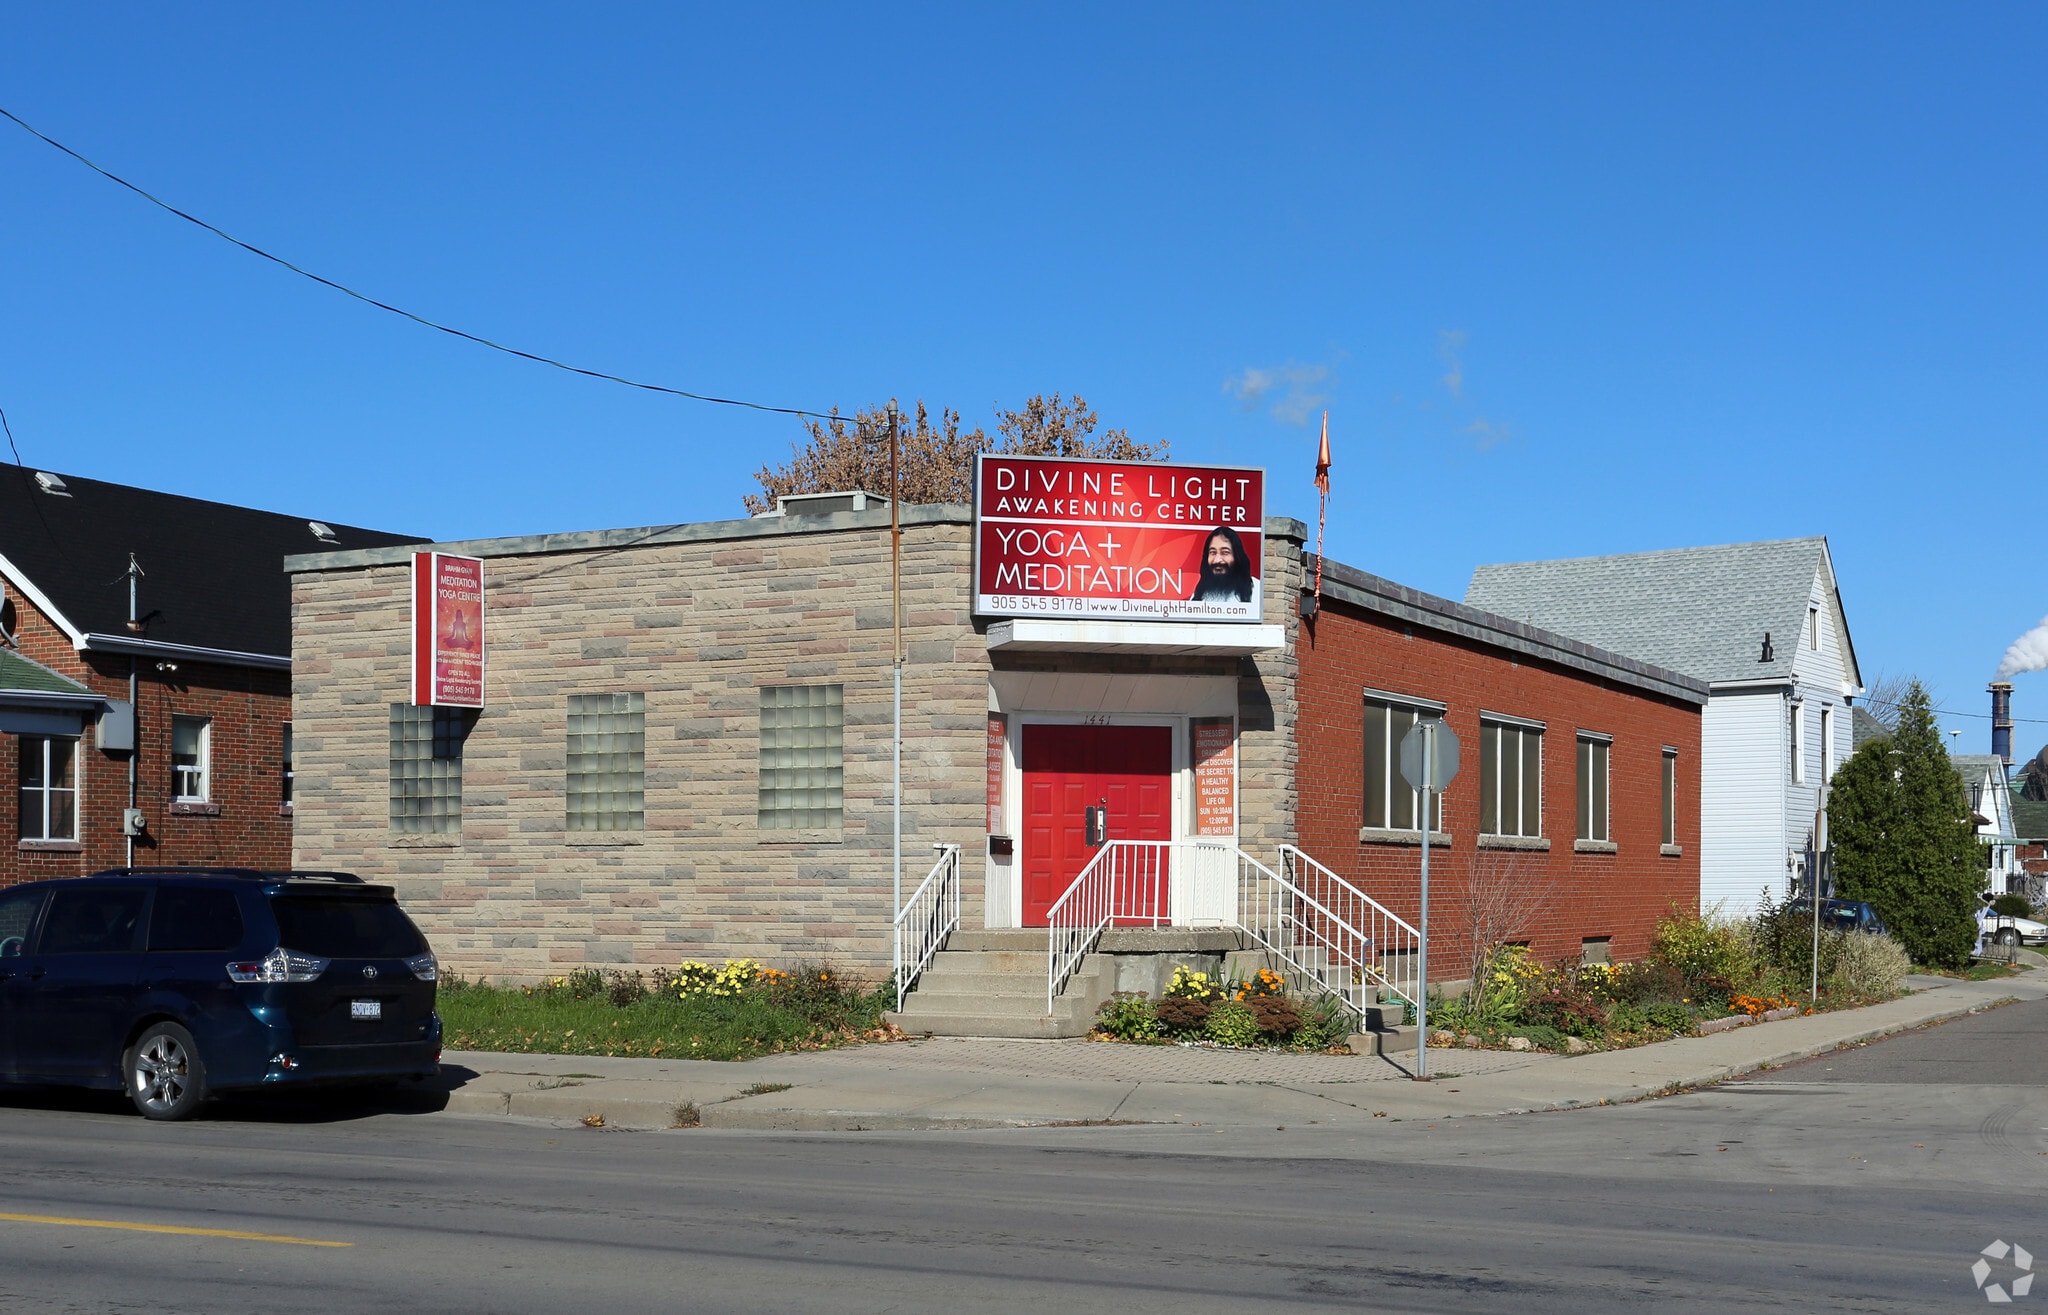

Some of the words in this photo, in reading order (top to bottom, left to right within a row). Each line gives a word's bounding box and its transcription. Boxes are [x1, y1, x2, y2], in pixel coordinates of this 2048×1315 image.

[996, 467, 1124, 496] DIVINE
[1148, 474, 1250, 501] LIGHT
[996, 496, 1143, 517] AWAKENING
[1157, 503, 1246, 522] CENTER
[995, 527, 1091, 558] YOGA
[440, 575, 477, 588] MEDITATION
[995, 562, 1182, 595] MEDITATION
[438, 588, 456, 600] YOGA
[457, 591, 481, 603] CENTRE
[991, 595, 1017, 609] 905
[1021, 597, 1047, 610] 545
[1051, 598, 1083, 611] 9178
[1090, 599, 1247, 618] www.DivineLightHamilton.com
[1084, 715, 1111, 725] 1441
[1196, 768, 1206, 776] THE
[1206, 768, 1226, 776] SECRET
[1201, 787, 1229, 796] BALANCED
[1217, 797, 1225, 805] ON
[1200, 807, 1210, 815] SUN
[1212, 826, 1221, 834] 545
